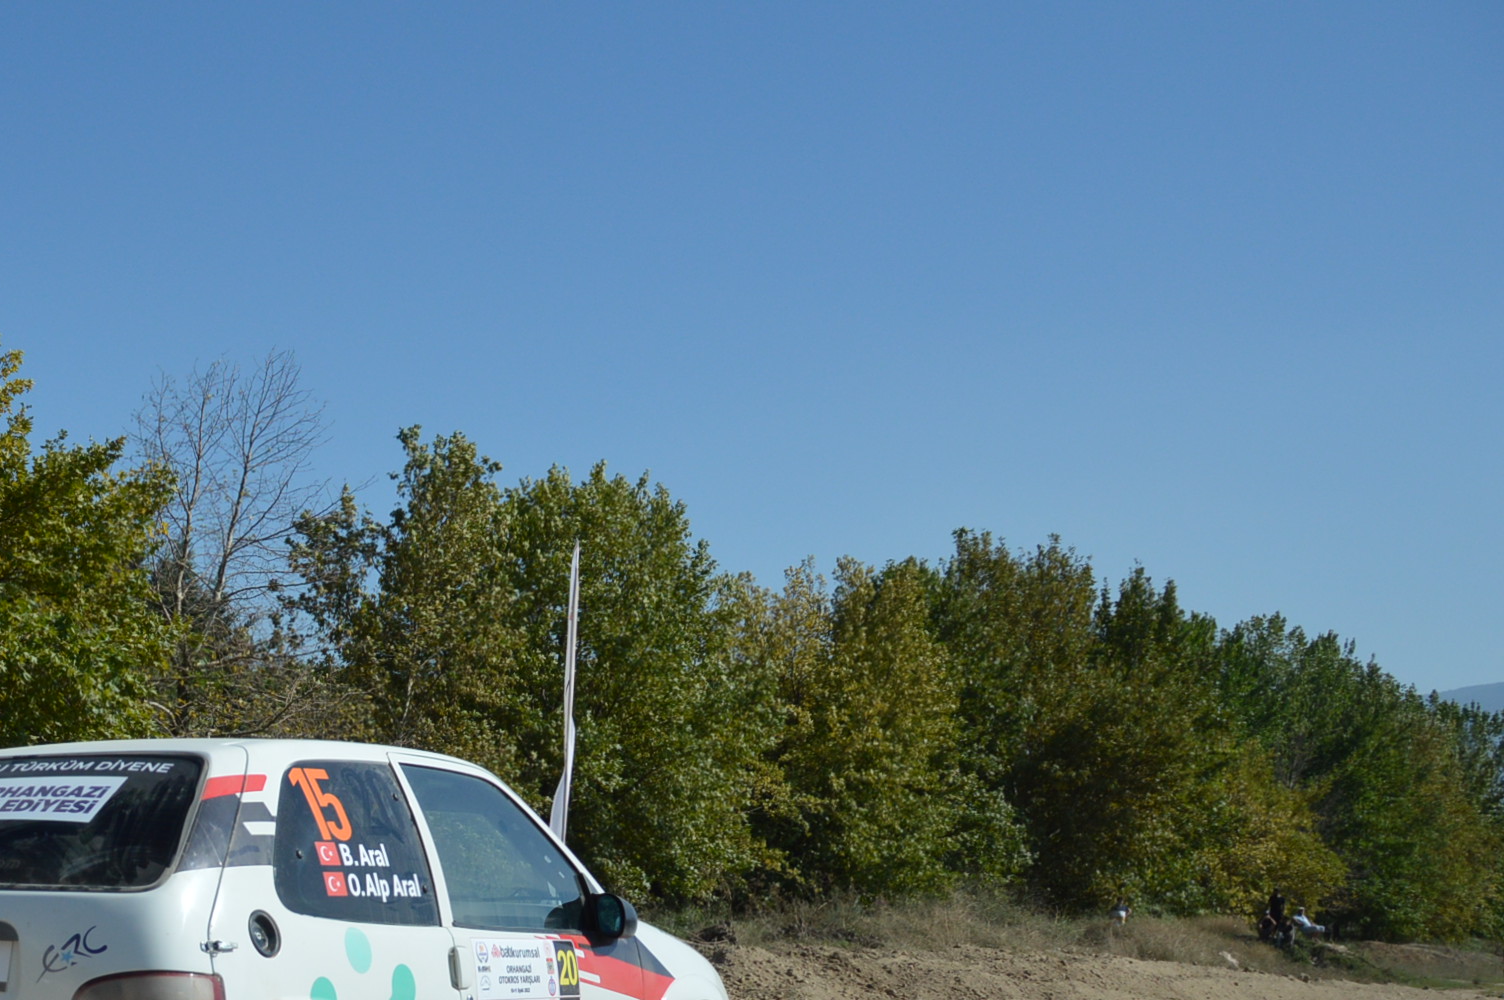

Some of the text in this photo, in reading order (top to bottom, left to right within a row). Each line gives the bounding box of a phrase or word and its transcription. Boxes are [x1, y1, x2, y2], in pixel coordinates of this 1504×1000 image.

[10, 760, 94, 772] TÜRKÜM
[95, 759, 174, 773] DİYENE
[288, 767, 353, 842] 15
[347, 872, 421, 903] O.Alp Aral
[557, 949, 578, 986] 20
